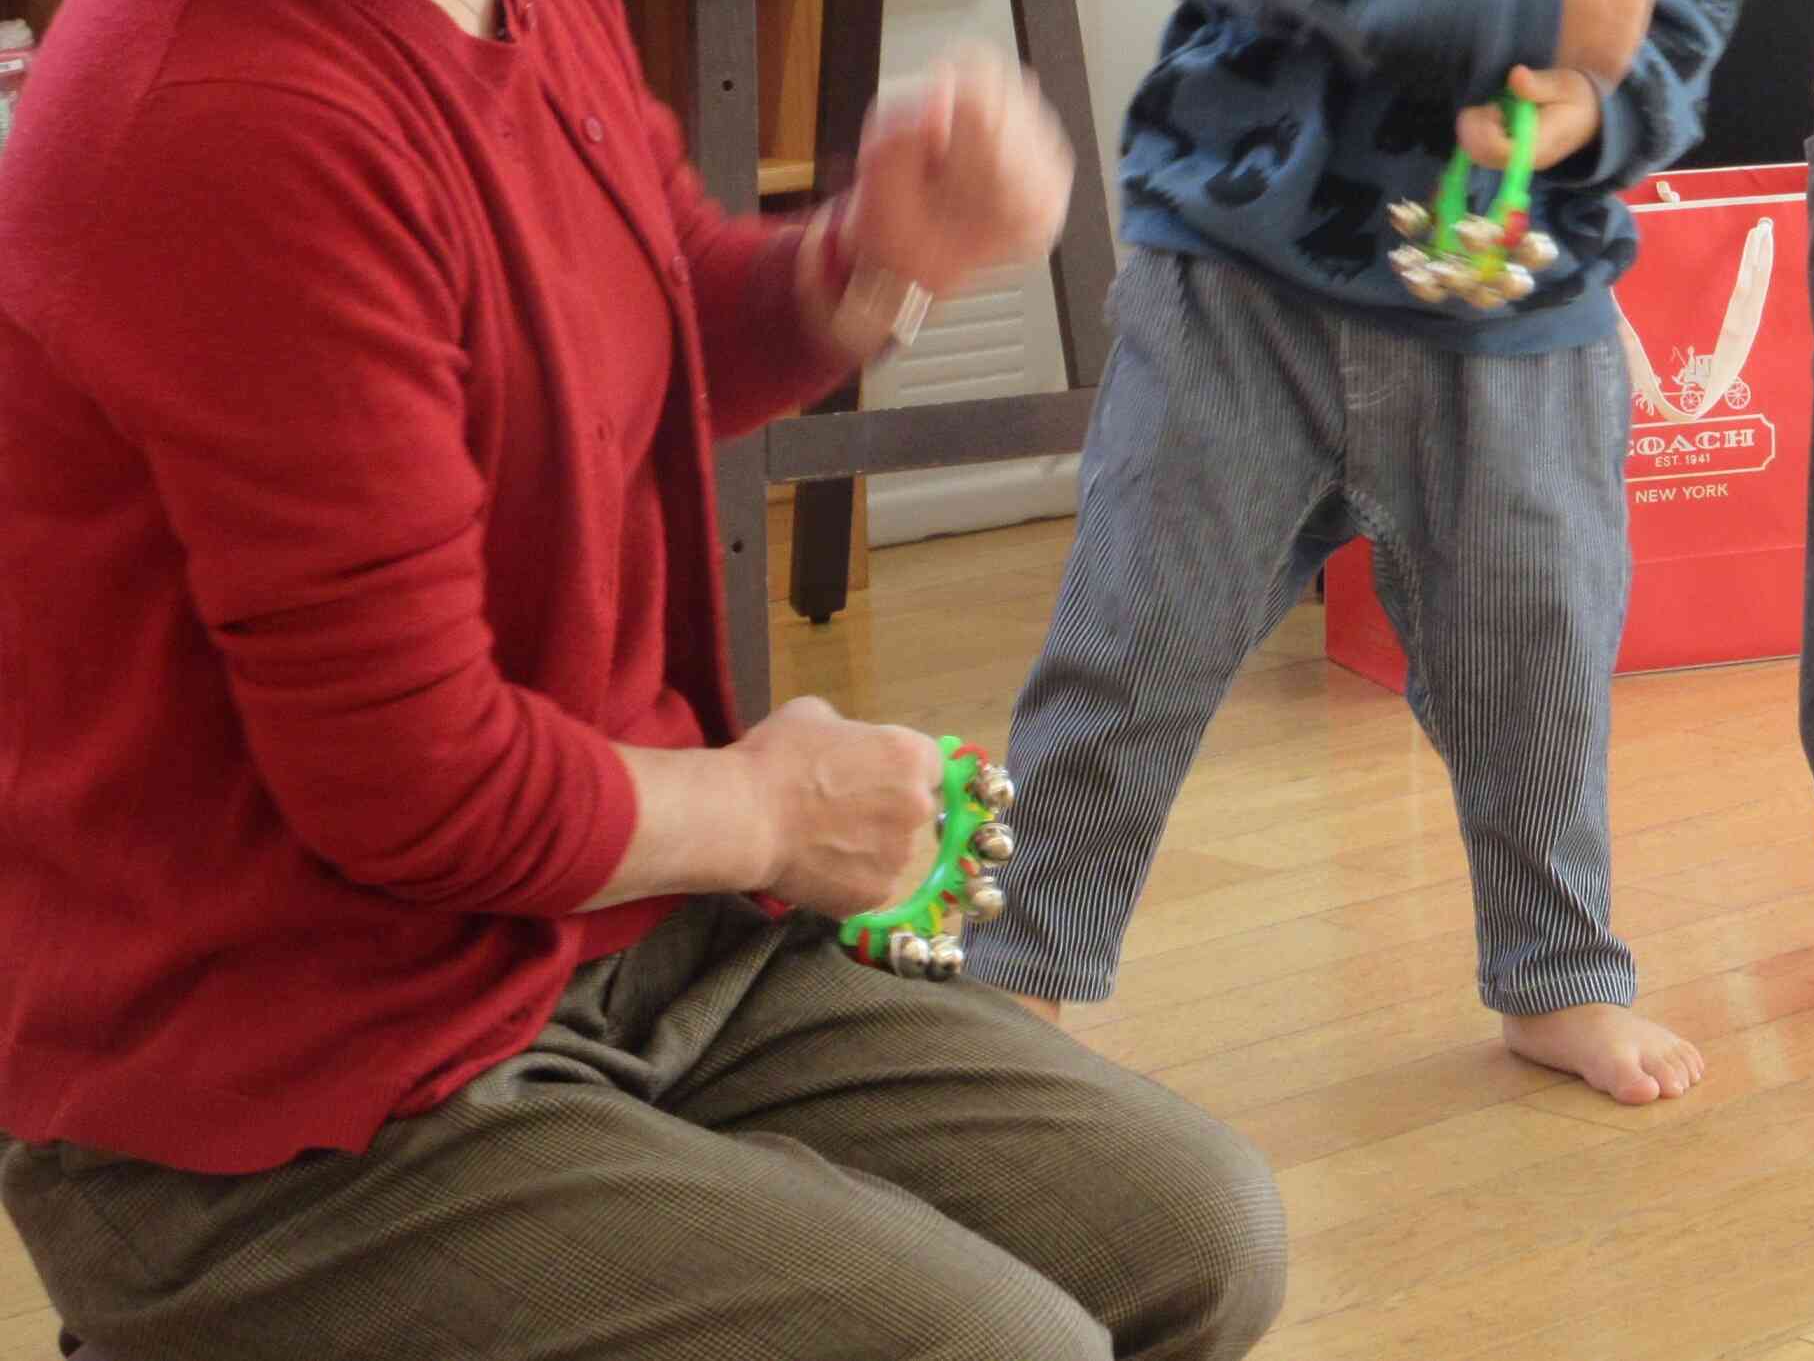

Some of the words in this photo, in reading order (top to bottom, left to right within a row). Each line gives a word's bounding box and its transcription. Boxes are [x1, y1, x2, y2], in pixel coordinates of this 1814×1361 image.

[1654, 454, 1681, 468] EST.
[1685, 453, 1711, 465] 1941
[1635, 488, 1677, 503] NEW
[1682, 483, 1728, 500] YORK
